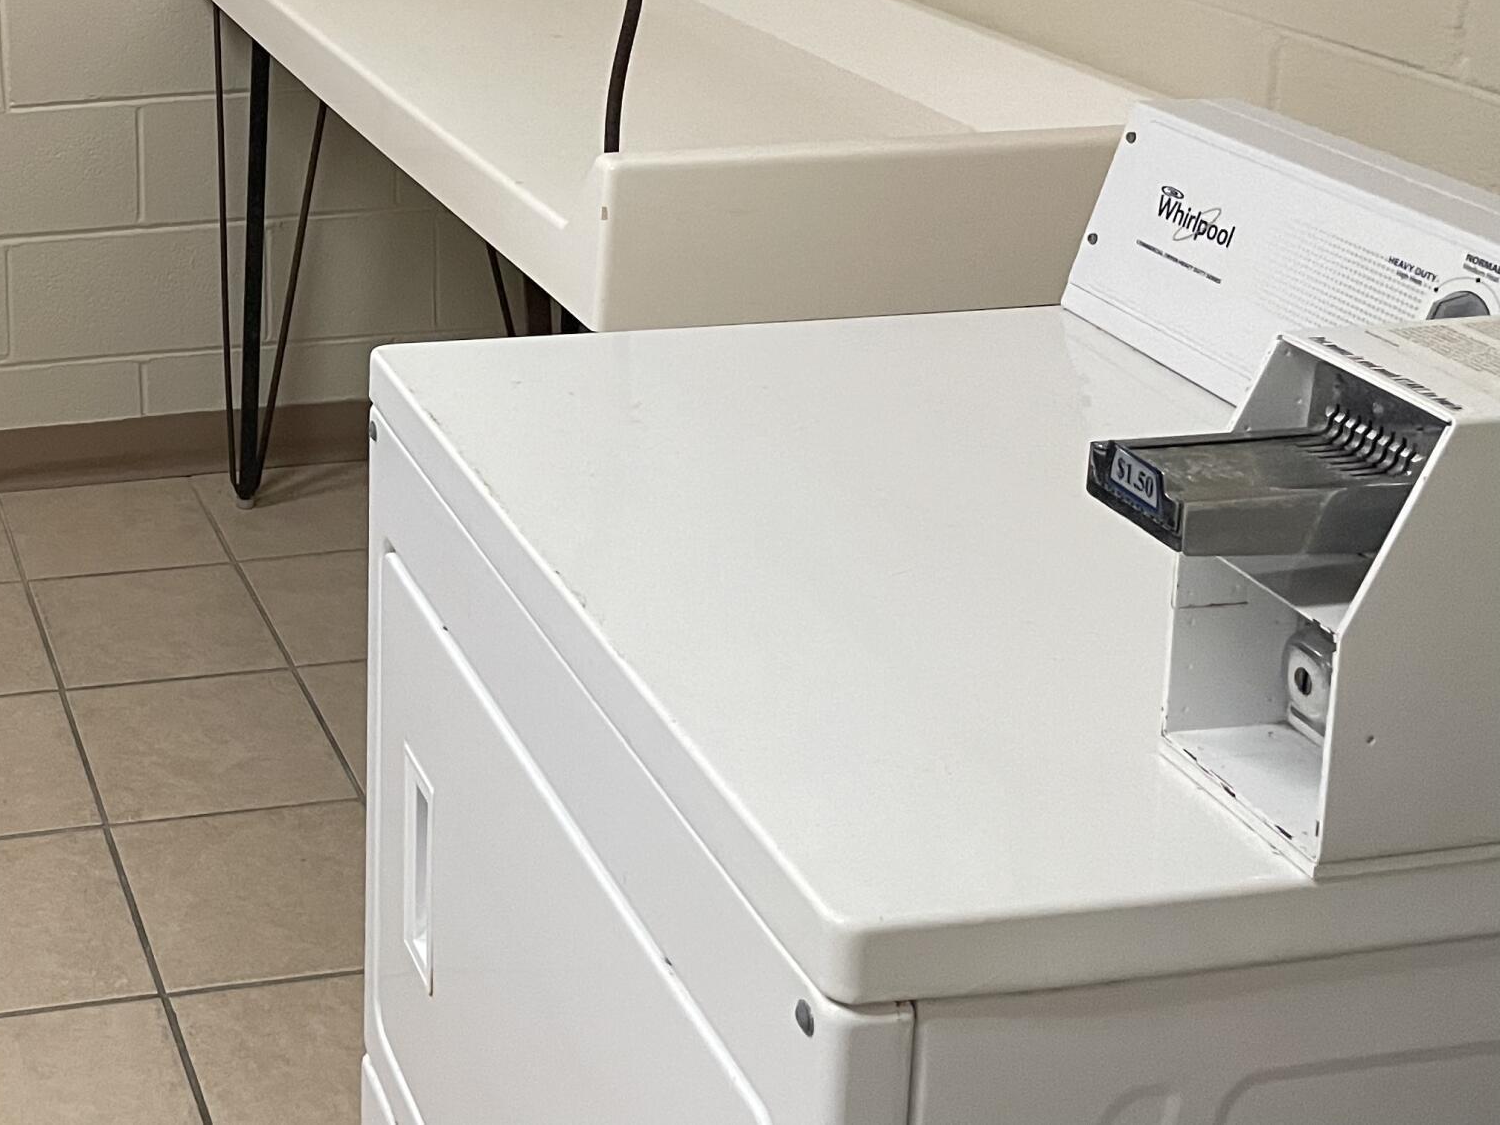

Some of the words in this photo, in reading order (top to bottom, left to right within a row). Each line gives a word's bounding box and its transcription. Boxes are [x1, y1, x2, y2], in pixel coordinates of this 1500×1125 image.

[1158, 194, 1236, 249] Whirlpool
[1388, 255, 1416, 273] HEAVY
[1414, 267, 1438, 283] DUTY
[1117, 457, 1154, 499] $1.50
